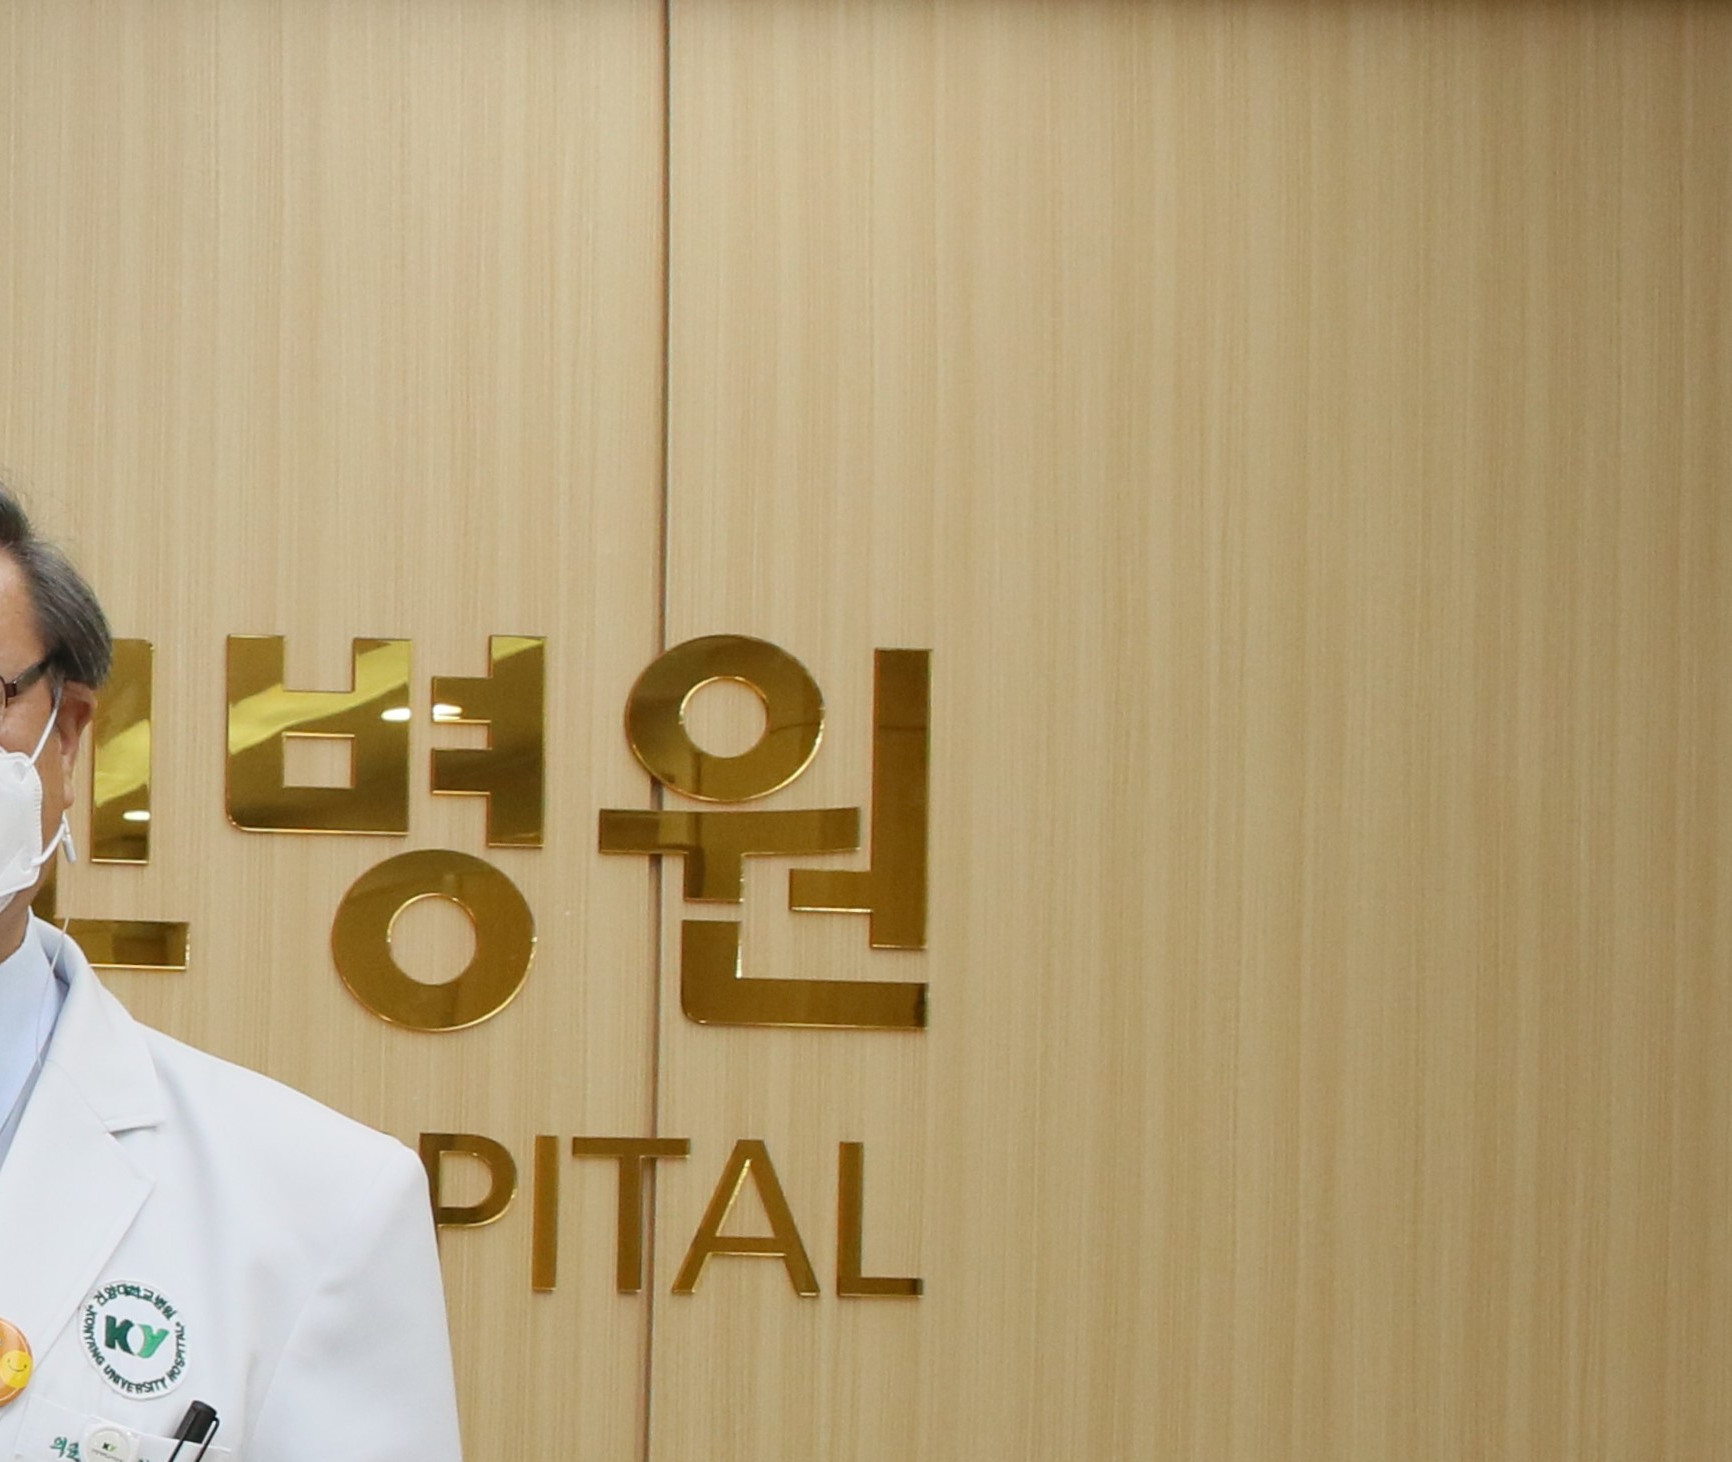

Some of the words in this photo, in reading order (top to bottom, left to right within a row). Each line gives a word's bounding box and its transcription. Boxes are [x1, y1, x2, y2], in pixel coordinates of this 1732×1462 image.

[419, 1131, 925, 1299] PITAL
[83, 1308, 106, 1366] KONYANG
[103, 1364, 168, 1394] UNIVERSITY
[165, 1325, 186, 1383] HOSPITAL
[104, 1315, 170, 1359] KY
